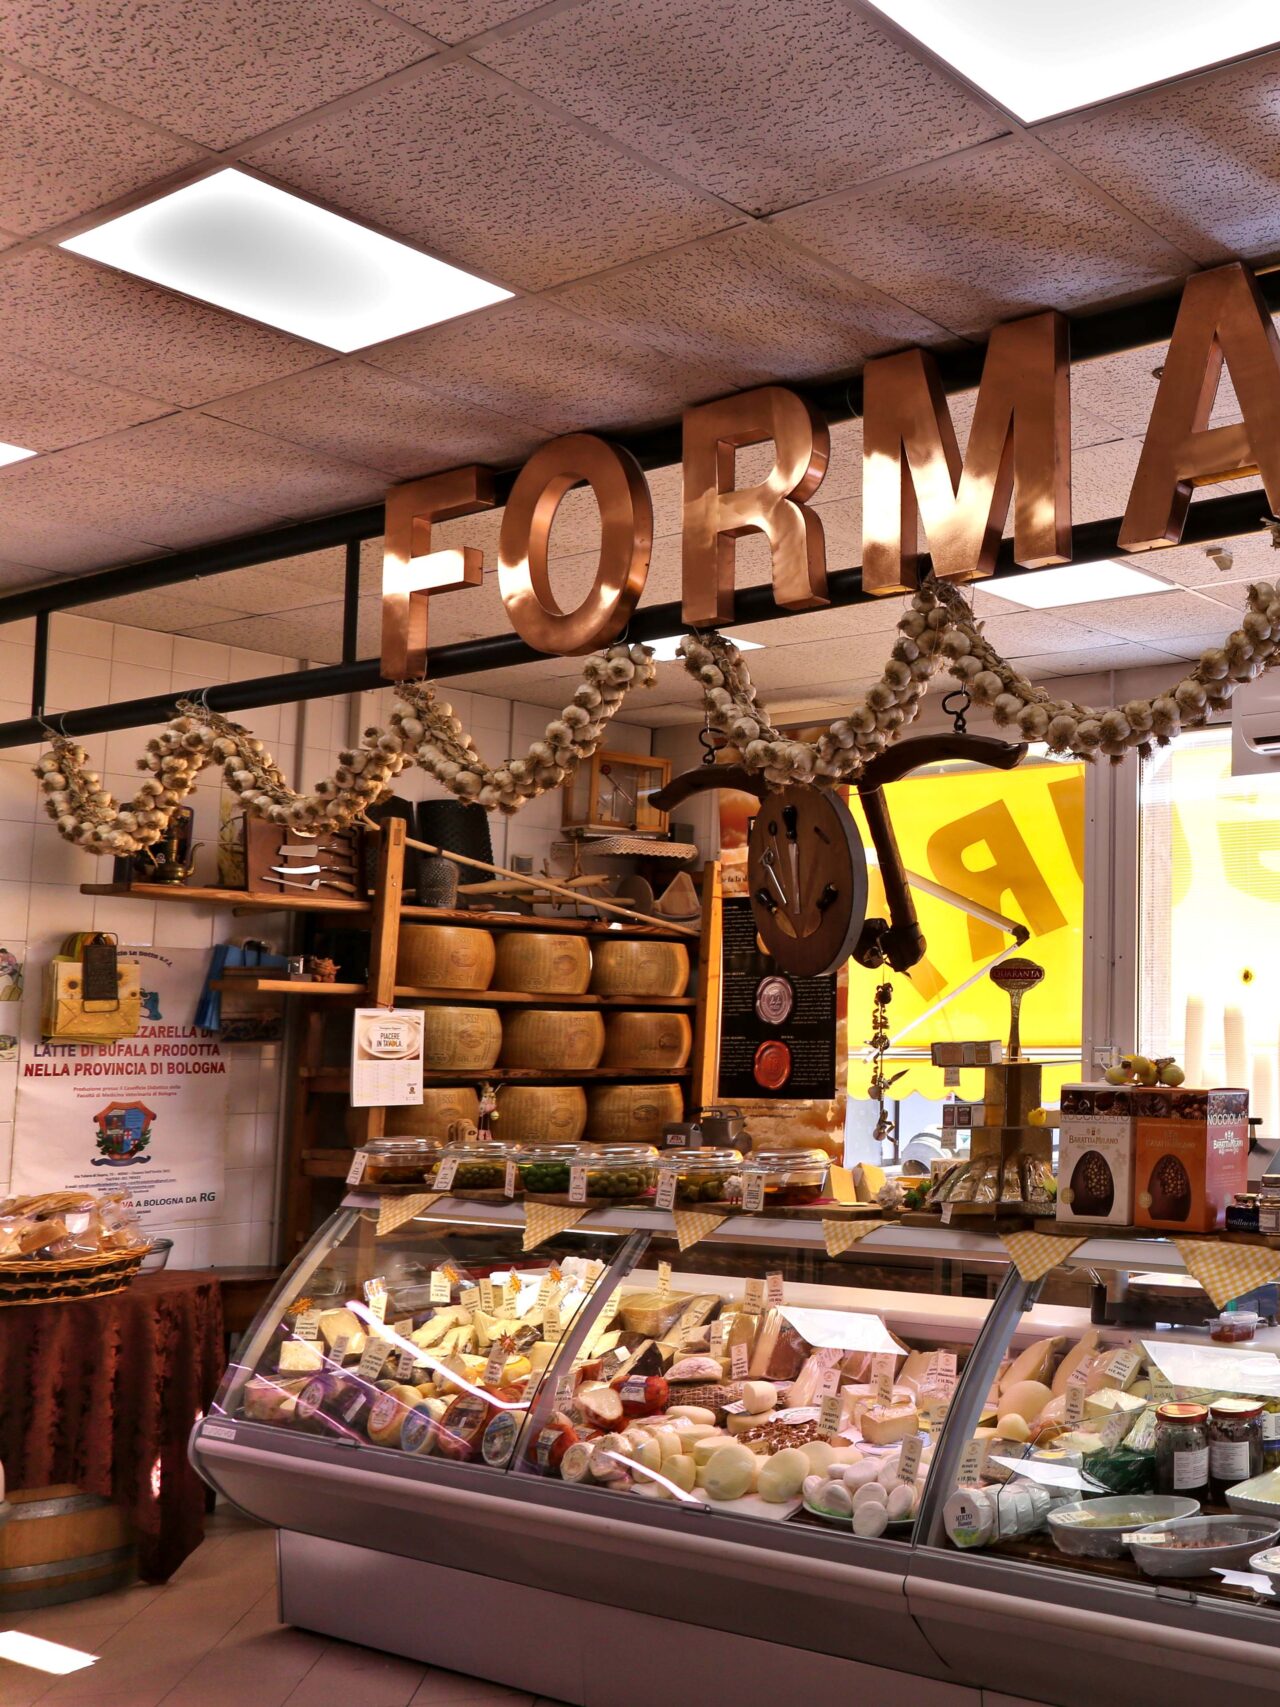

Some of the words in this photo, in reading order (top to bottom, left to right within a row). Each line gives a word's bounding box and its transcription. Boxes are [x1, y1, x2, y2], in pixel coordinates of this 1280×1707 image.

[132, 1025, 198, 1039] ZZARELLA
[34, 1044, 76, 1058] LATTE
[81, 1044, 95, 1058] DI
[100, 1044, 150, 1057] BUFALA
[154, 1043, 221, 1057] PRODOTTA
[24, 1063, 71, 1078] NELLA
[74, 1062, 147, 1076] PROVINCIA
[151, 1062, 164, 1075] DI
[167, 1061, 226, 1074] BOLOGNA
[144, 1197, 184, 1207] BOLOGNA
[200, 1192, 216, 1202] RG
